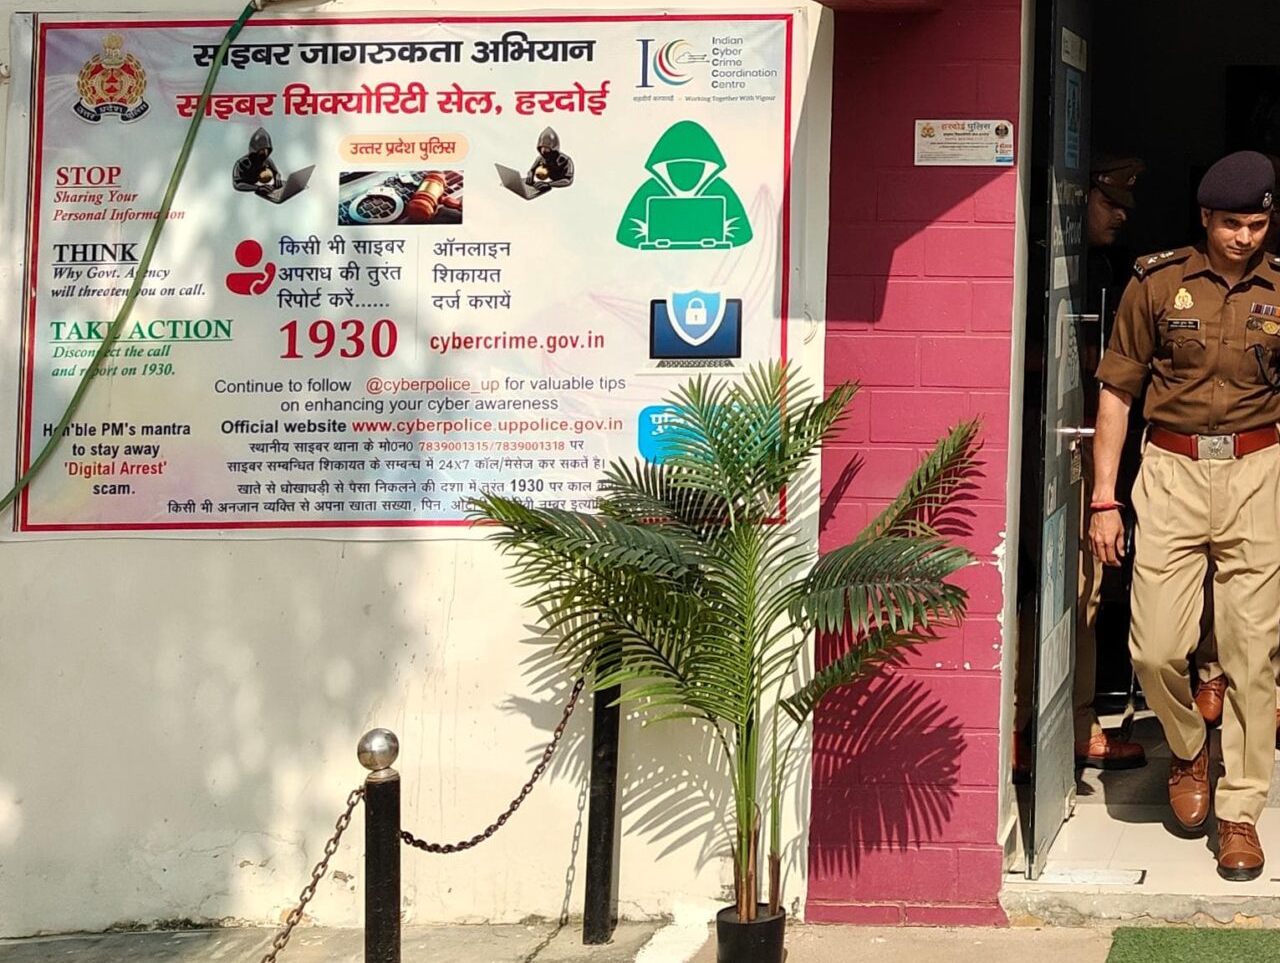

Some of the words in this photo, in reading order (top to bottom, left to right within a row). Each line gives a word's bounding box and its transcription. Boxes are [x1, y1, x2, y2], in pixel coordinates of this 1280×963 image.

[712, 37, 743, 45] Indian
[192, 43, 293, 70] साइबर
[471, 31, 596, 64] अभियान
[712, 48, 742, 57] Cyber
[712, 58, 742, 66] Crime
[711, 69, 777, 77] Coordination
[711, 80, 745, 88] Centre
[176, 94, 277, 120] साइबर
[283, 82, 428, 116] सिक्योरिटी
[437, 83, 502, 115] सेल,
[515, 80, 611, 116] हरदोई
[386, 137, 415, 157] प्रदेश
[420, 137, 455, 161] पुलिस
[56, 166, 121, 185] STOP
[54, 191, 103, 205] Sharing
[108, 190, 138, 202] Your
[53, 209, 106, 221] Personal
[110, 208, 185, 223] Informaion
[53, 243, 138, 262] THINK
[278, 235, 321, 255] किसी
[328, 235, 345, 255] भी
[352, 239, 406, 255] साइबर
[433, 238, 511, 259] ऑनलाइन
[53, 268, 82, 281] Why
[87, 267, 120, 279] Govt.
[278, 266, 332, 282] अपराध
[339, 261, 360, 281] की
[367, 263, 402, 286] तुरंत
[432, 263, 501, 283] शिकायत
[51, 286, 74, 297] will
[159, 286, 177, 296] on
[179, 284, 205, 296] call.
[277, 287, 321, 308] रिपोर्ट
[432, 290, 461, 309] दर्ज
[468, 290, 512, 309] करायें
[129, 319, 234, 340] ACTION
[280, 318, 398, 359] 1930
[430, 331, 605, 354] cybercrime.gov.in
[125, 345, 143, 357] the
[148, 344, 171, 357] call
[52, 365, 75, 376] and
[122, 366, 136, 376] on
[142, 364, 175, 375] 1930.
[214, 379, 283, 393] Continue
[288, 379, 302, 392] to
[307, 378, 352, 392] follow
[366, 377, 500, 395] @cyberpolice_up
[505, 377, 525, 390] for
[530, 376, 594, 390] valuable
[599, 377, 626, 392] tips
[280, 401, 299, 411] on
[305, 398, 384, 414] enhancing
[389, 399, 423, 413] your
[428, 398, 470, 412] cyber
[475, 398, 558, 410] awareness
[102, 423, 136, 436] PM's
[141, 424, 191, 435] mantra
[221, 420, 278, 434] Official
[284, 419, 347, 433] website
[72, 444, 85, 456] to
[90, 444, 119, 458] stay
[124, 445, 160, 458] away
[93, 484, 135, 494] scam.
[511, 479, 543, 492] 1930
